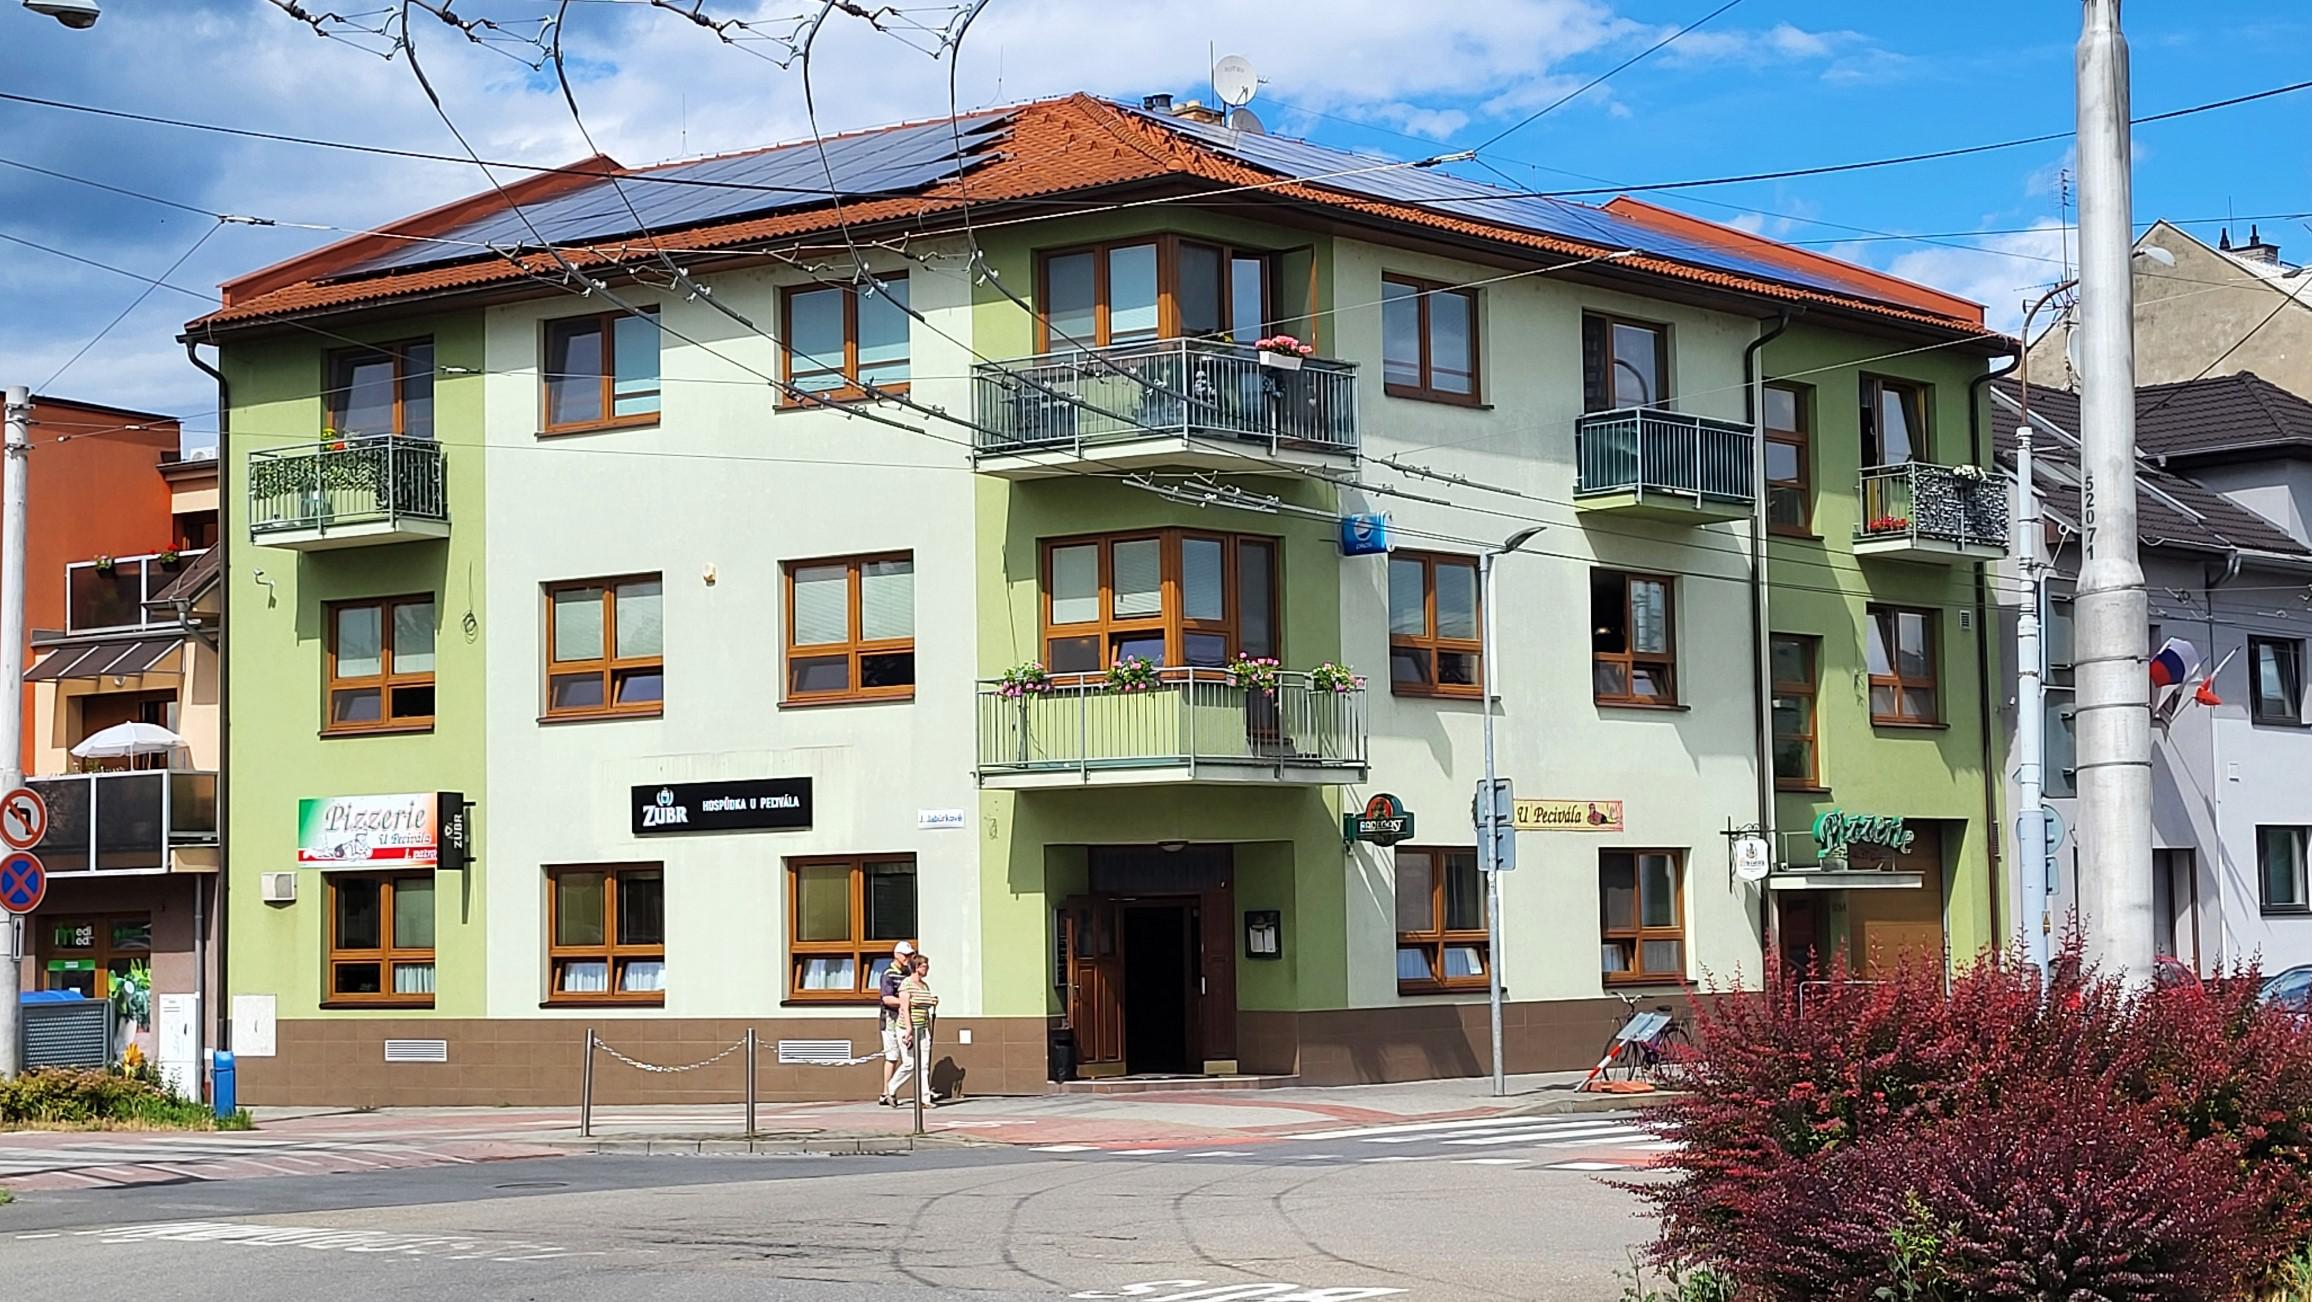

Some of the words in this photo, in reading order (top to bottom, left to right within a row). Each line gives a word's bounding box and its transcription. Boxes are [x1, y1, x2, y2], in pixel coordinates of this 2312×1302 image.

[2085, 475, 2097, 561] 52071
[750, 797, 757, 810] U
[1517, 806, 1529, 824] U
[1534, 804, 1582, 825] Pecivála
[325, 801, 427, 832] Pizzerie
[642, 805, 689, 827] ZUBR
[379, 833, 388, 845] U
[453, 814, 463, 849] ZUBR
